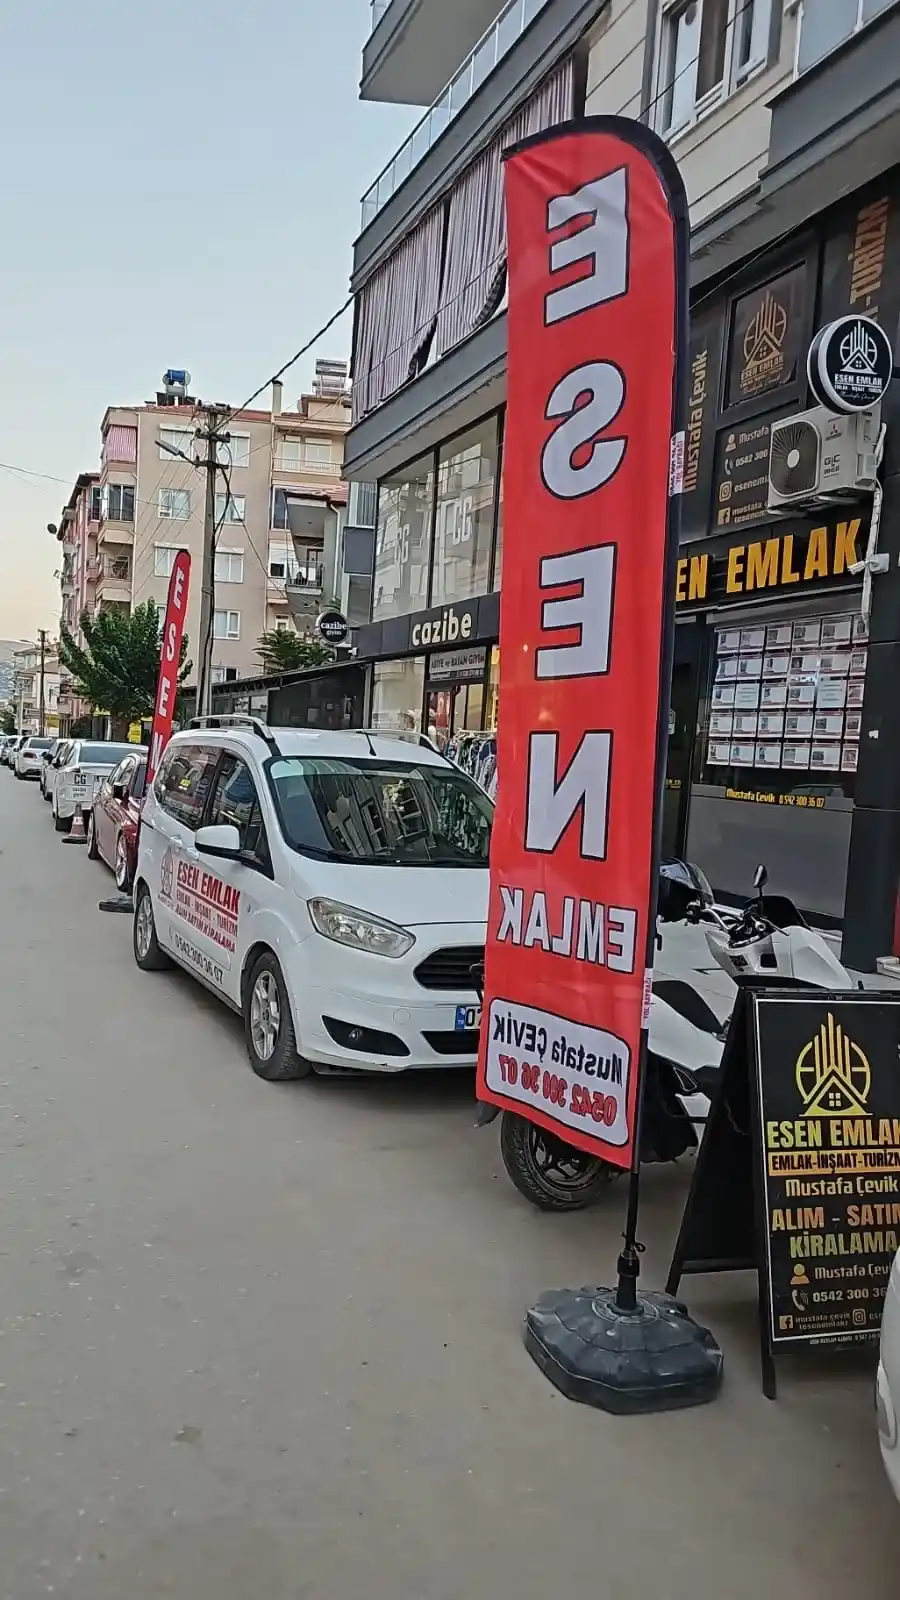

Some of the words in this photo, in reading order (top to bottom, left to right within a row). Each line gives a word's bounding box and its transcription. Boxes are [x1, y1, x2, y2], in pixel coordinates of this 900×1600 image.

[688, 349, 707, 407] Çevik
[834, 373, 855, 384] ESEN
[856, 375, 882, 386] EMLAK
[738, 426, 769, 444] Mustafa
[735, 453, 753, 467] 0542
[676, 553, 708, 602] EN
[726, 518, 862, 594] EMLAK
[320, 621, 348, 630] cazibe
[411, 608, 472, 646] cazibe
[151, 565, 185, 769] ESEN
[73, 773, 87, 785] CG
[726, 788, 755, 801] Mustafa
[176, 860, 200, 890] ESEN
[200, 872, 241, 915] EMLAK
[213, 965, 224, 985] 07
[766, 1120, 823, 1149] ESEN
[785, 1176, 854, 1198] Mustafa
[856, 1175, 898, 1197] Çevik
[771, 1206, 825, 1231] ALIM
[789, 1231, 899, 1259] KİRALAMA
[814, 1263, 866, 1280] Mustafa
[812, 1290, 844, 1303] 0542
[846, 1288, 869, 1299] 300
